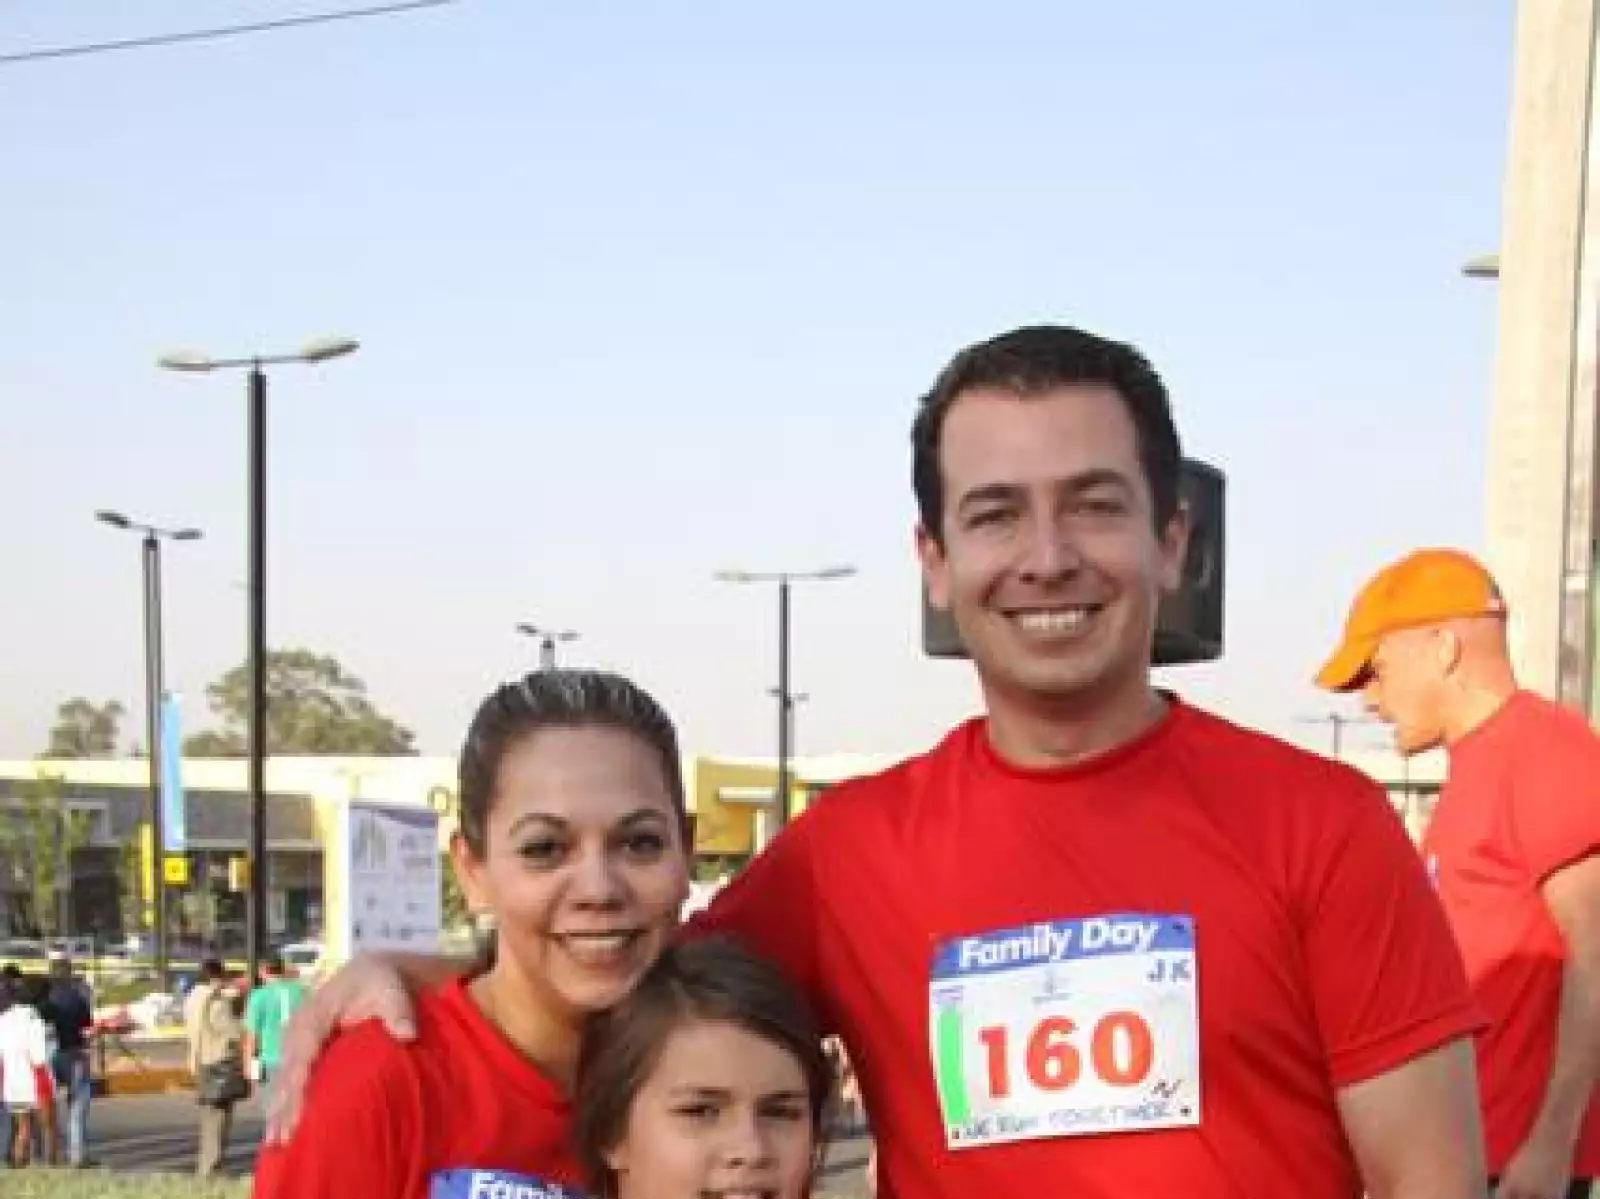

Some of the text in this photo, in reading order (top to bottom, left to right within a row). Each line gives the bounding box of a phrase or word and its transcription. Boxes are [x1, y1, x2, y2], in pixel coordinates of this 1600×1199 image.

[959, 918, 1158, 968] Family Day
[978, 1010, 1154, 1099] 160
